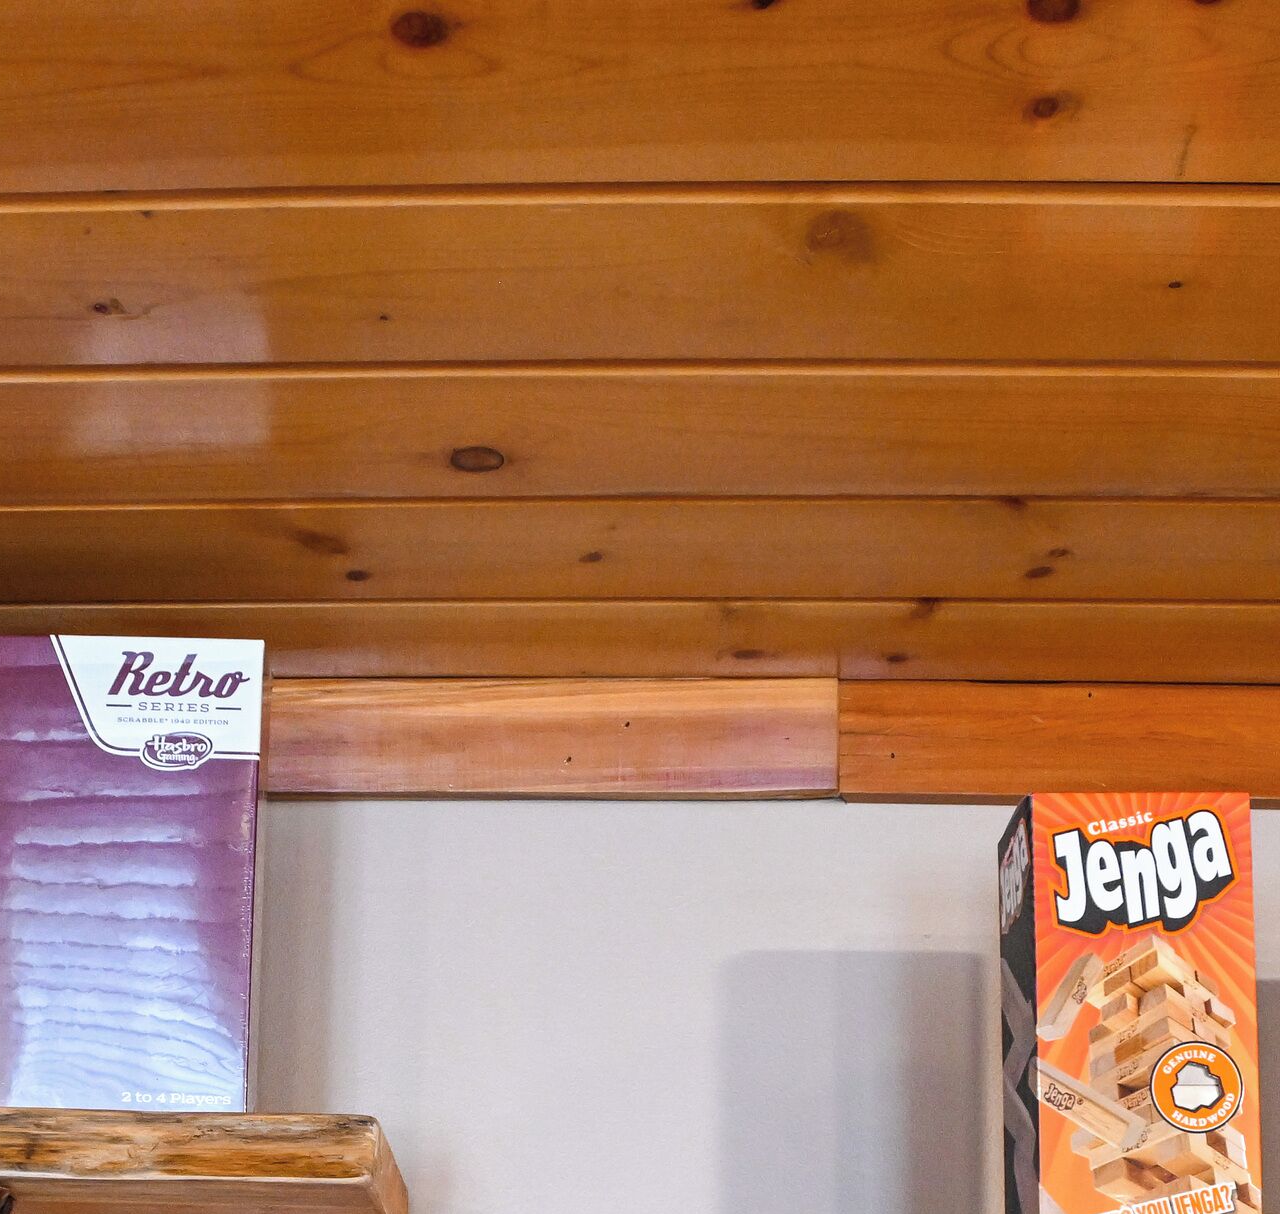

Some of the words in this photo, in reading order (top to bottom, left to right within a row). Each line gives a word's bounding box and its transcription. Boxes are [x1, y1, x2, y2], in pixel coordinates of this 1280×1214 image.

[107, 651, 251, 698] Retro
[138, 702, 210, 713] SERIES
[147, 735, 207, 754] Hasbro
[156, 750, 196, 764] Gaming
[1087, 811, 1154, 835] Classic
[1054, 809, 1232, 924] Jenga
[1162, 1050, 1217, 1076] GENUINE
[121, 1092, 132, 1103] 2
[135, 1092, 152, 1103] to
[156, 1093, 167, 1104] 4
[170, 1093, 232, 1107] Players
[1044, 1083, 1077, 1111] Jenga
[1171, 1092, 1236, 1127] HARDWOOD
